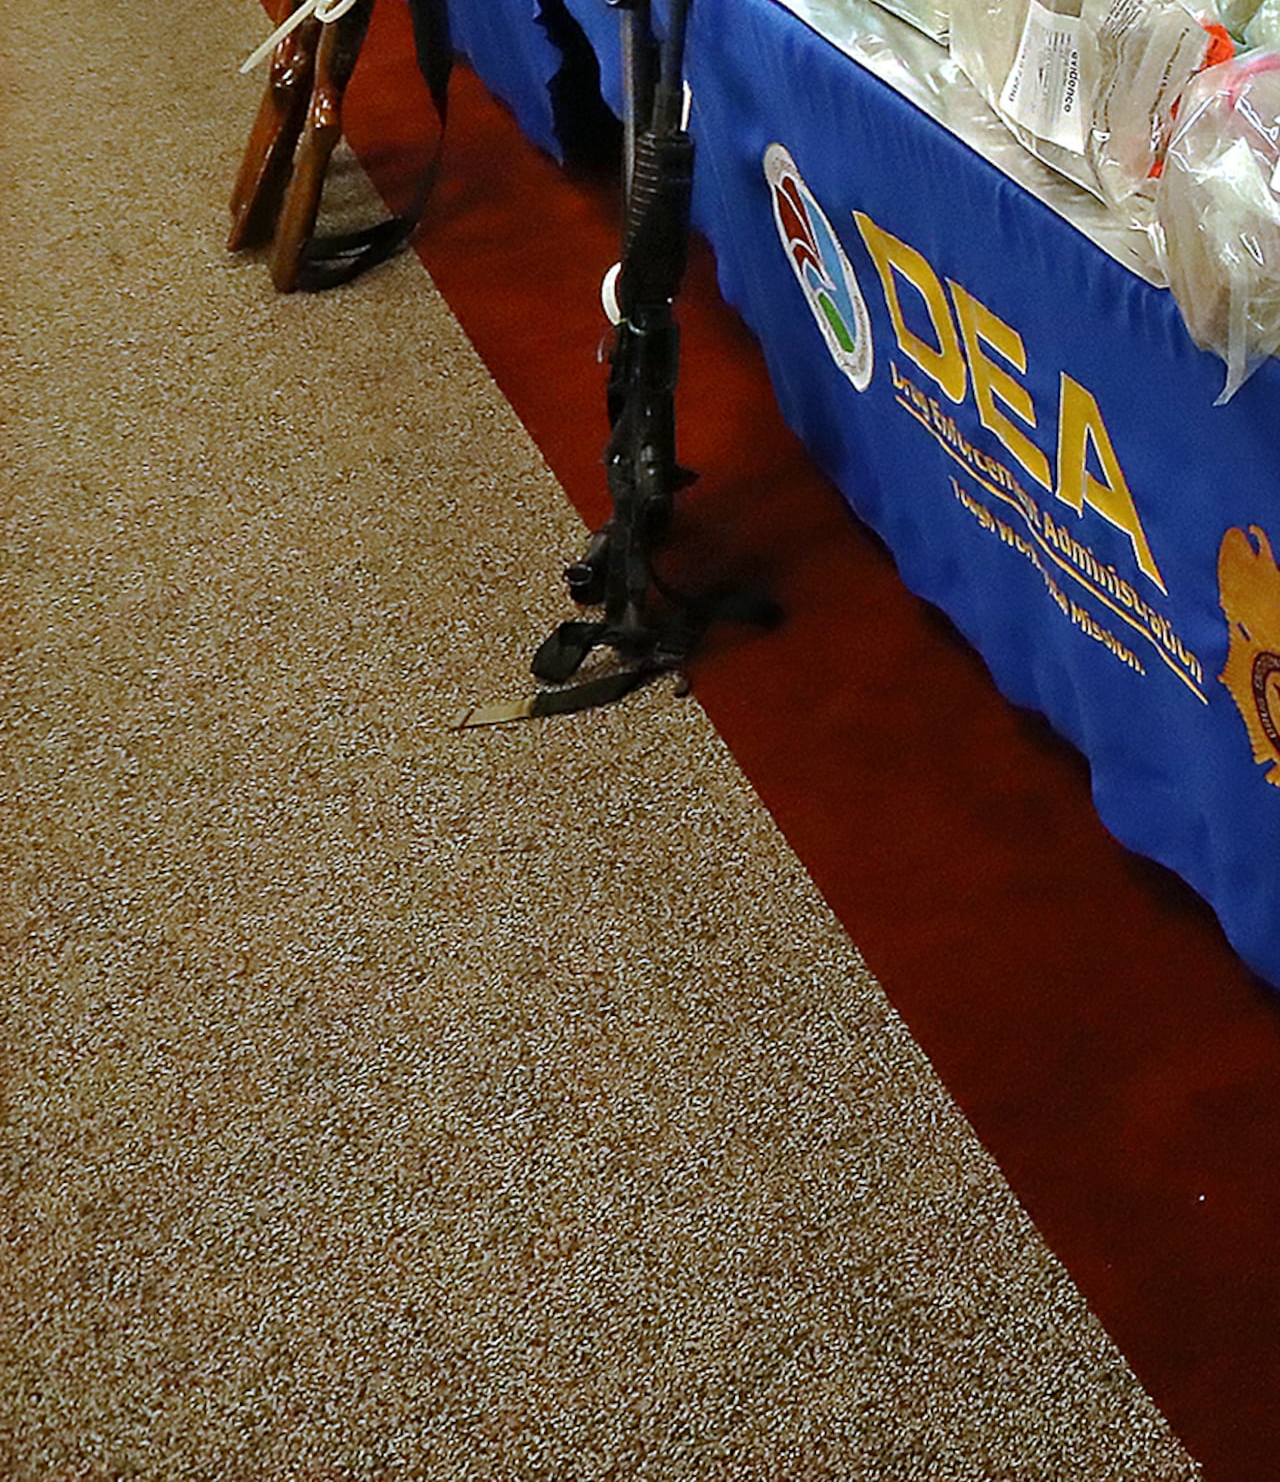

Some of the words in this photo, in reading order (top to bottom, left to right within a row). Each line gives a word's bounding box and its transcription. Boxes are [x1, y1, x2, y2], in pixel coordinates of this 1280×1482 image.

[852, 209, 1168, 597] DEA
[1042, 510, 1203, 682] Administration
[1070, 605, 1146, 676] Mission.
